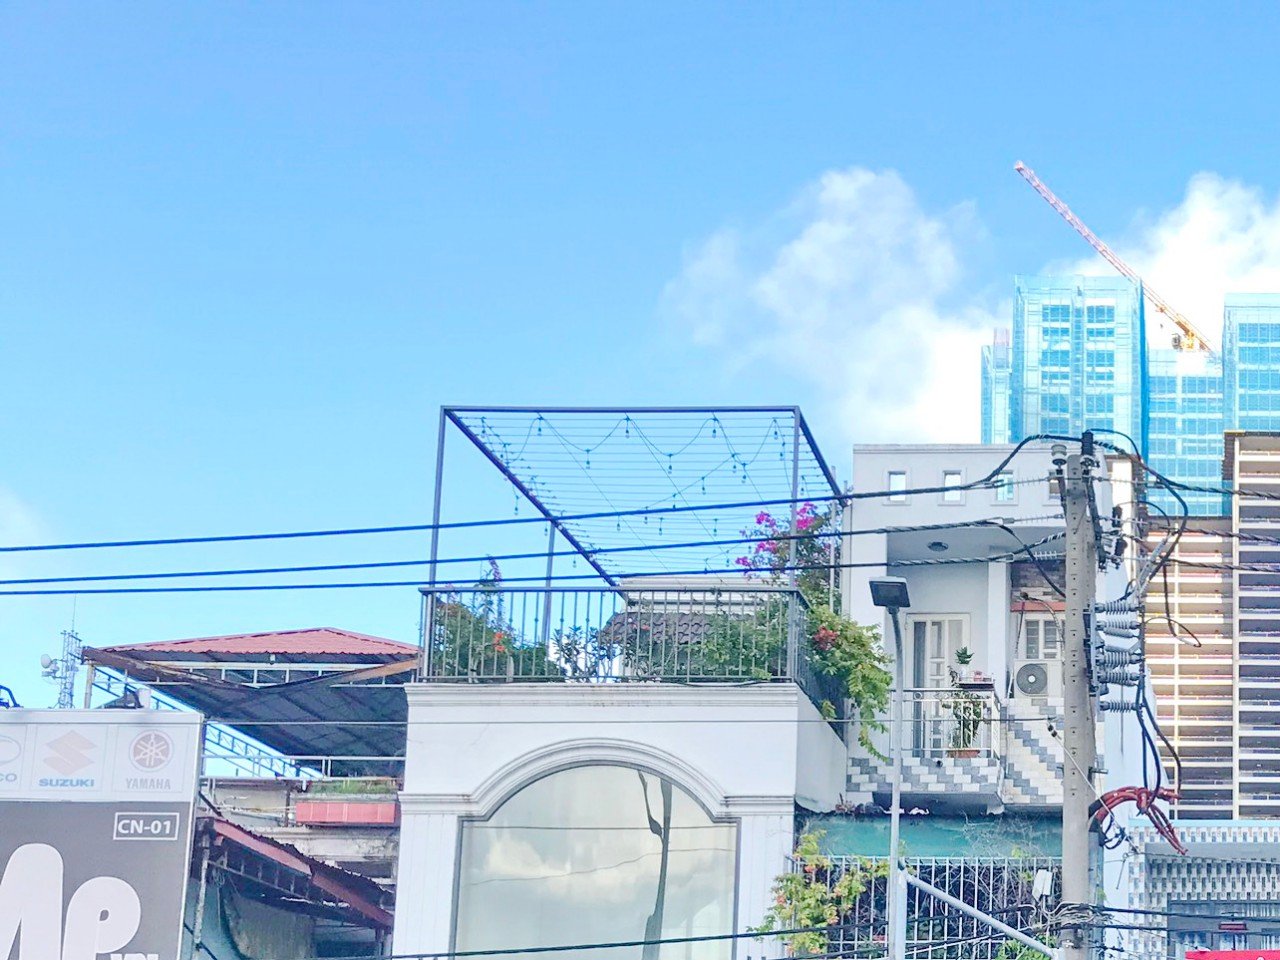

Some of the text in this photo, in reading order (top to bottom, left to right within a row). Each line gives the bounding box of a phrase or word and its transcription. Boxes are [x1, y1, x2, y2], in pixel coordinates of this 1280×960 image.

[39, 778, 94, 787] SUZUKI
[126, 778, 171, 790] YAMAHA
[118, 819, 171, 834] CN-01
